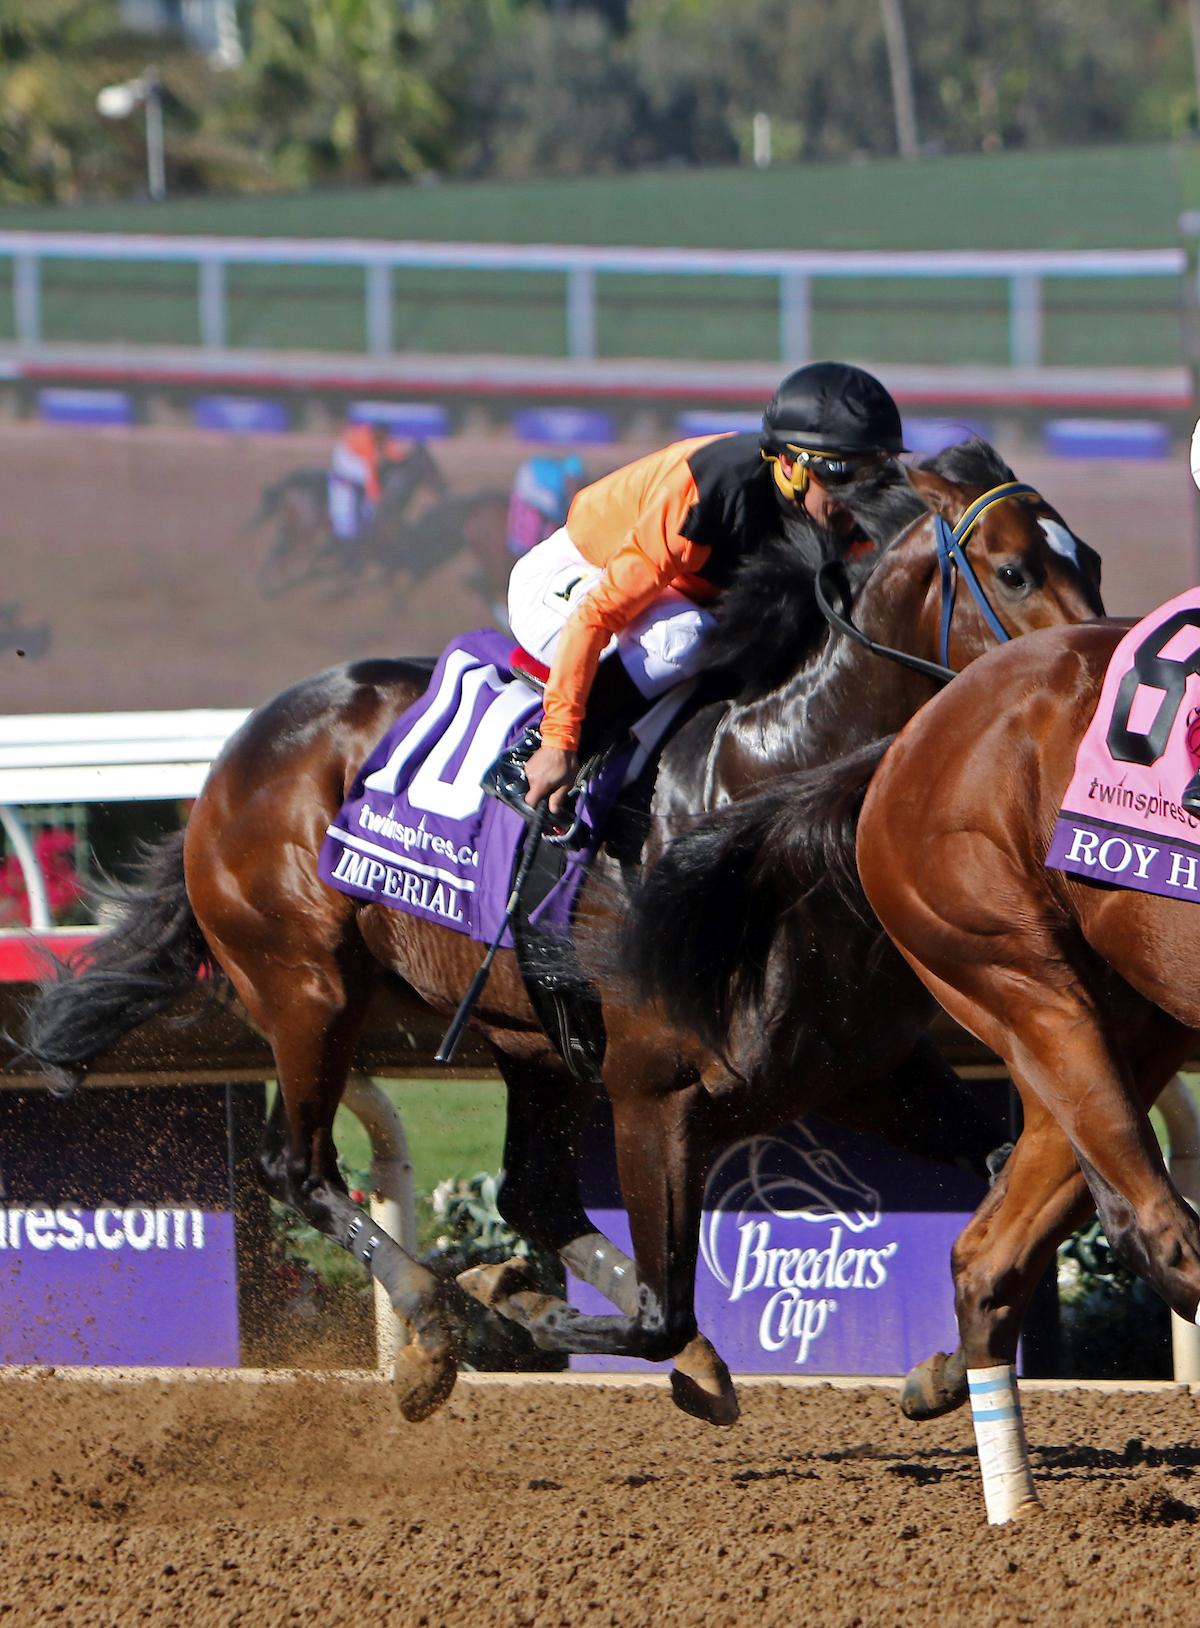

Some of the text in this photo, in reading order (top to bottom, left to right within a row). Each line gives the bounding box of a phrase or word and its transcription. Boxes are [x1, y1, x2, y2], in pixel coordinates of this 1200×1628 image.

[363, 648, 543, 821] 10
[332, 847, 464, 922] IMPERIAL
[1065, 828, 1199, 891] ROY H
